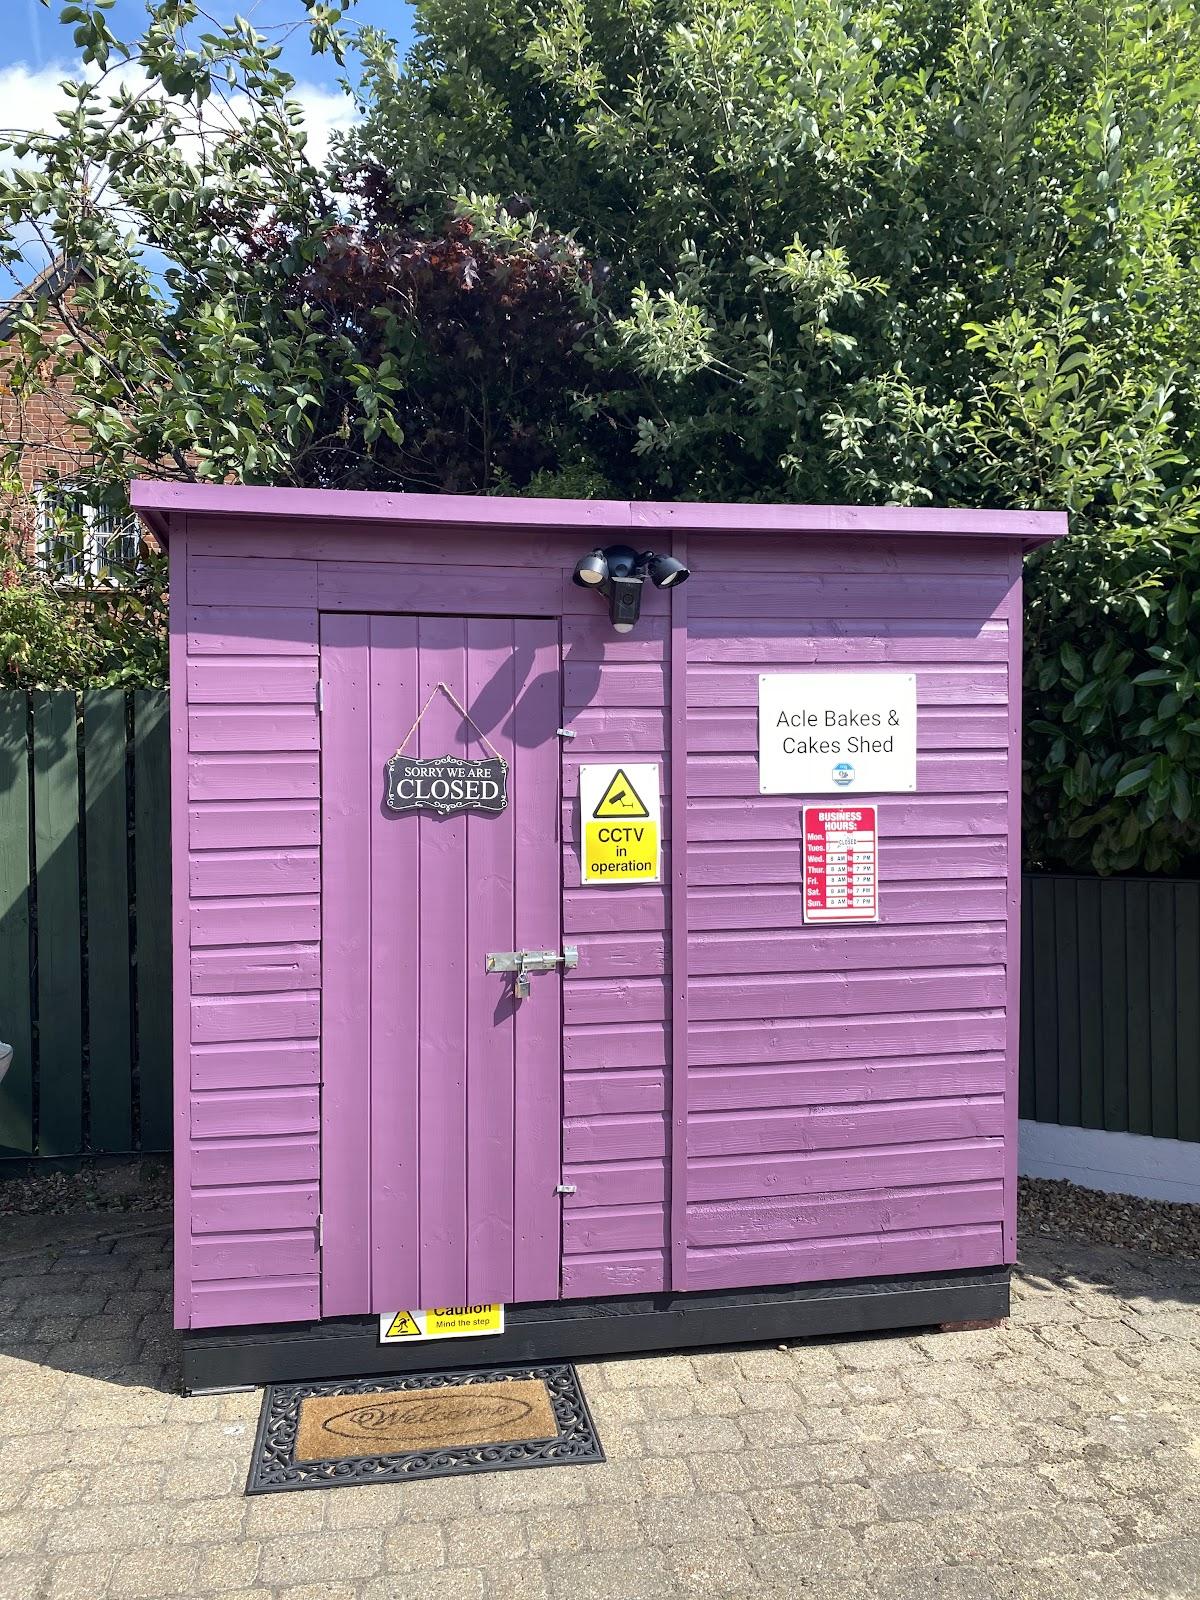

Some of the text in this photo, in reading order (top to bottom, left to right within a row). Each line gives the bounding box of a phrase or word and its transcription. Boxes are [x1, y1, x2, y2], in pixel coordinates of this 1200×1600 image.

[776, 709, 900, 727] Acle Bakes &
[782, 735, 894, 754] Cakes Shed
[404, 767, 492, 778] SORRY WE ARE
[396, 779, 499, 799] CLOSED
[818, 812, 862, 821] BUSINESS
[824, 821, 857, 831] HOURS:
[598, 828, 644, 842] CCTV
[807, 833, 825, 841] Mon.
[616, 845, 627, 857] in
[807, 844, 825, 852] Tues.
[807, 855, 825, 863] Wed.
[591, 860, 652, 875] operation
[807, 866, 825, 874] Thur.
[807, 877, 819, 885] Fri.
[807, 888, 820, 896] Sat.
[807, 899, 823, 907] Sun.
[433, 1304, 491, 1317] Caution
[436, 1318, 490, 1328] Mind the step
[350, 1402, 513, 1431] Welcome
